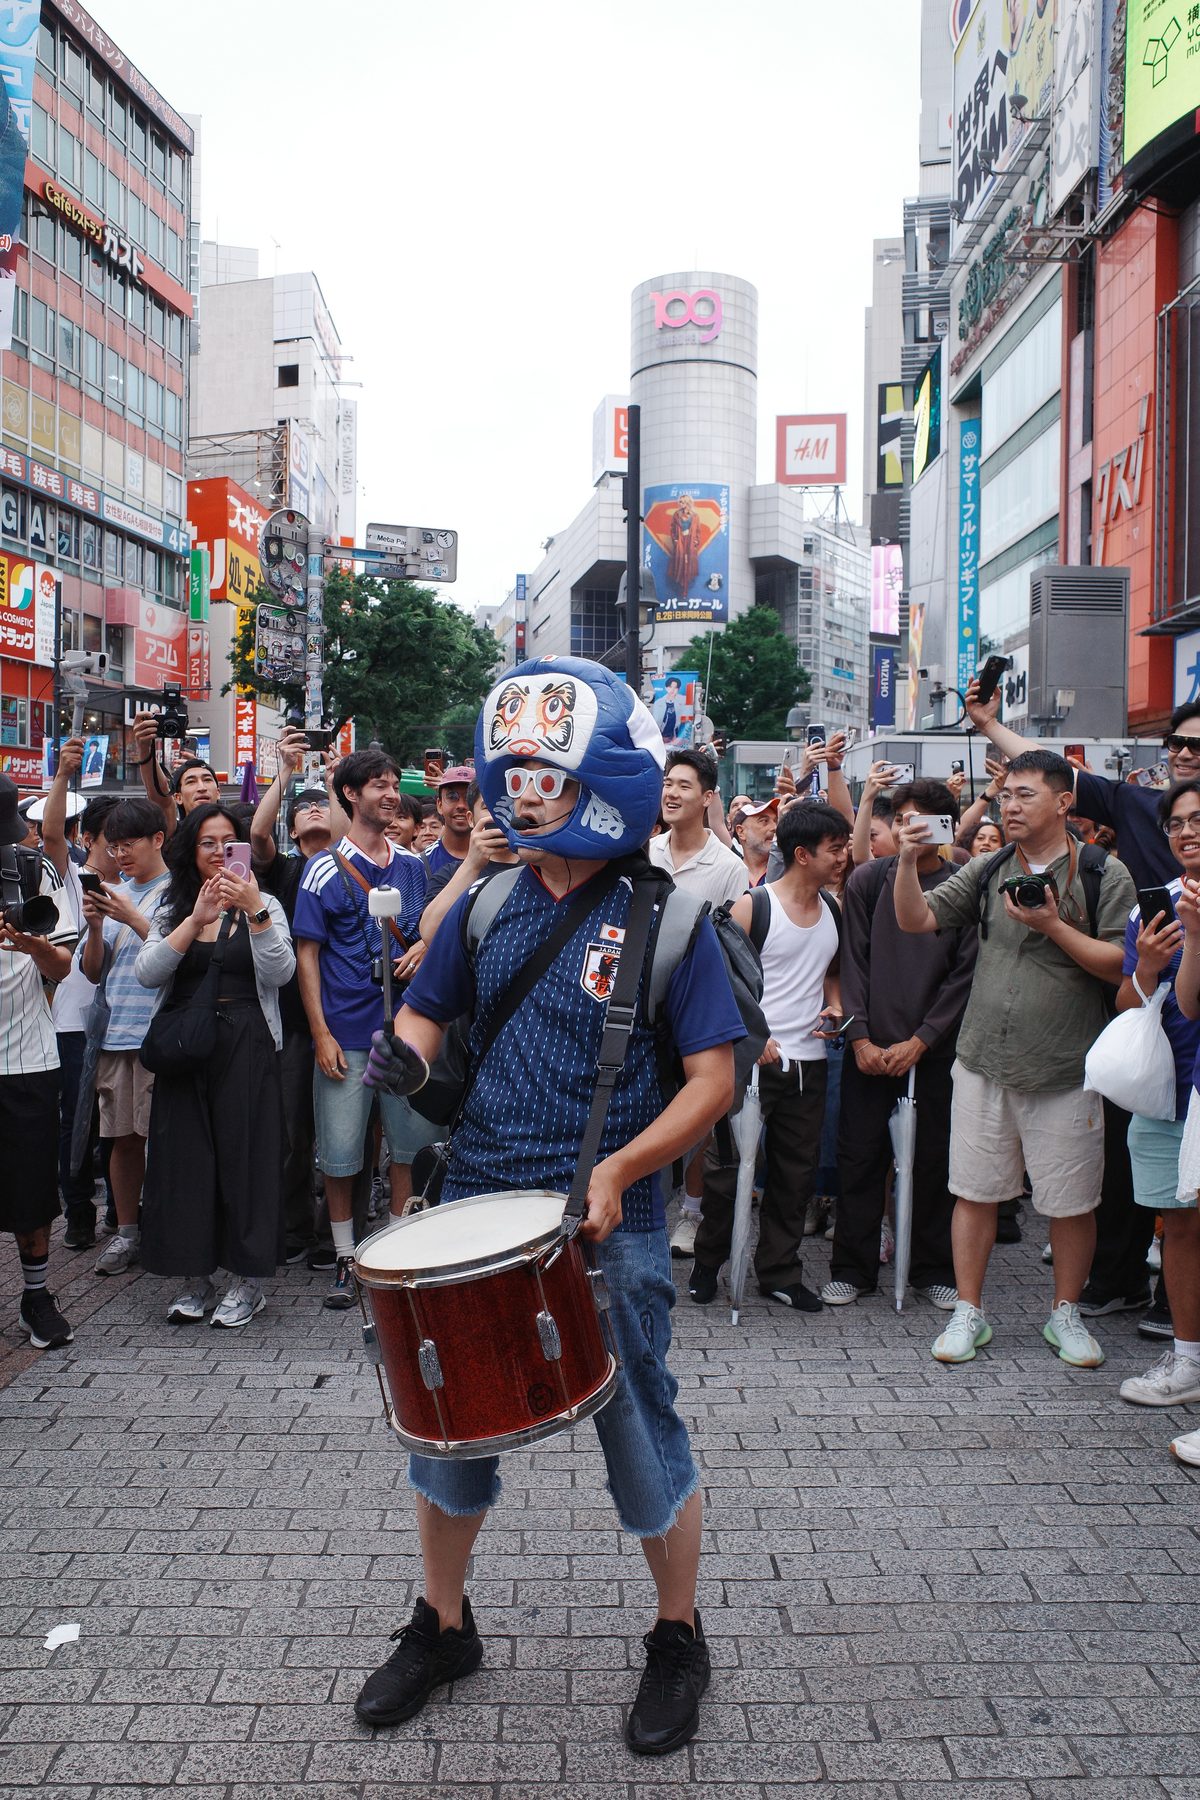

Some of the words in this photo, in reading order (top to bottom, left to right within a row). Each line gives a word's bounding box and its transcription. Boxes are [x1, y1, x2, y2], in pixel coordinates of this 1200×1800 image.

[957, 49, 1008, 171] 世界へ
[103, 225, 145, 277] ガスト
[649, 289, 723, 344] 109
[794, 437, 829, 461] H&M
[71, 482, 96, 511] 発毛
[168, 528, 187, 553] 4F
[960, 454, 977, 622] サマーフルーツギフト
[192, 573, 200, 596] レイク
[3, 612, 34, 628] COSMETIC
[142, 637, 178, 668] アコム
[191, 658, 200, 687] アコム
[881, 658, 890, 698] MIZUHO
[237, 701, 254, 764] スギ薬局
[598, 947, 621, 956] JAPAN
